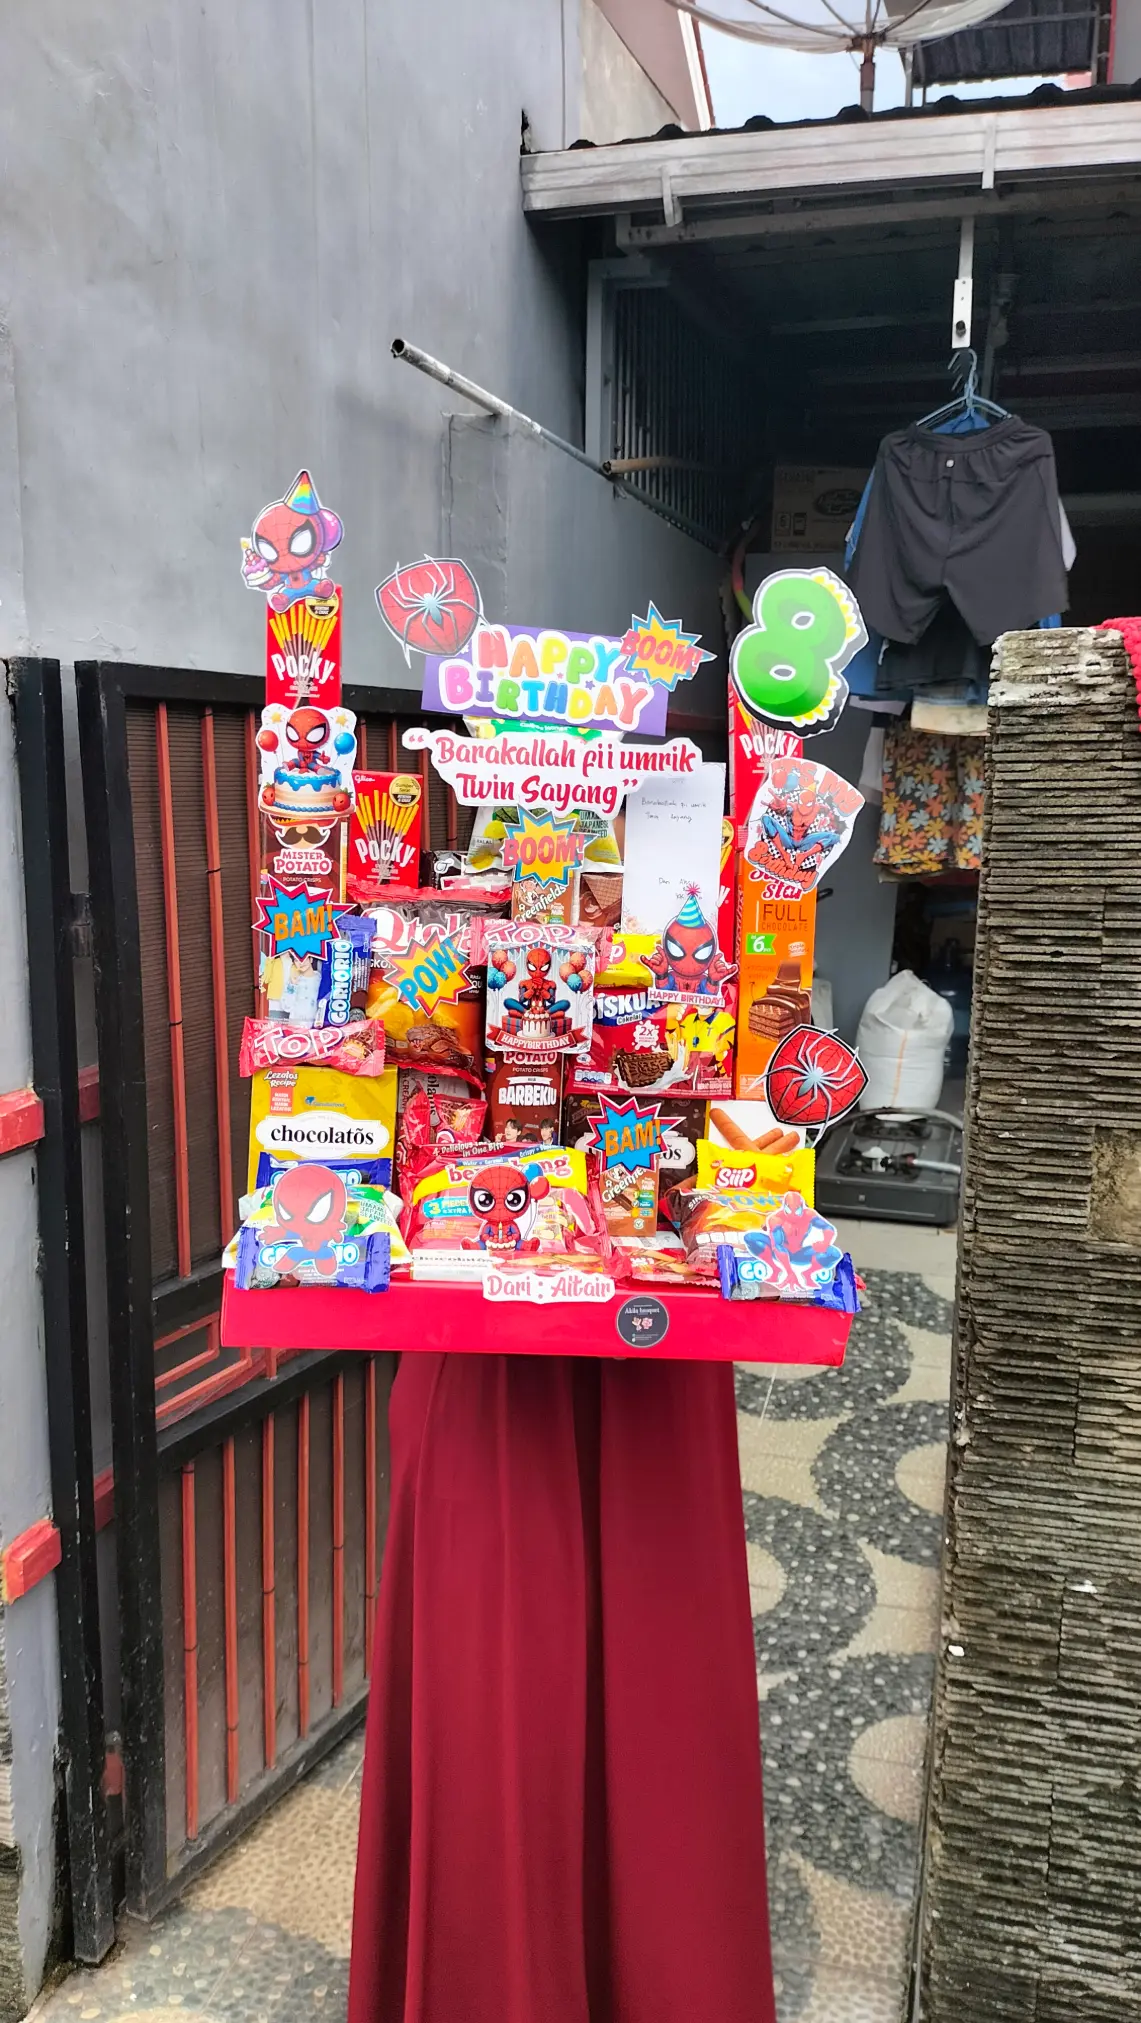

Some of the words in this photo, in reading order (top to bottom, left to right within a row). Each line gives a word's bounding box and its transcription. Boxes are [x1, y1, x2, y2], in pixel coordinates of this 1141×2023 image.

[477, 630, 620, 684] HAPPY
[620, 629, 703, 674] BOOM!
[736, 577, 848, 722] 8
[445, 664, 649, 725] BIRTHDAY
[620, 745, 697, 773] umrik
[456, 772, 515, 801] Twin
[282, 851, 323, 860] MISTER
[503, 834, 586, 867] BOOM!
[275, 859, 331, 873] POTATO
[273, 904, 334, 941] BAM!
[763, 903, 807, 922] FULL
[484, 923, 576, 945] TOP
[753, 935, 765, 953] 6
[328, 939, 353, 1026] GORIORIO
[398, 937, 466, 1010] POW!
[649, 989, 680, 1001] HAPPY
[681, 992, 724, 1006] BIRTHDAY!
[617, 1012, 642, 1025] Cokelat
[639, 1026, 654, 1036] 2x
[254, 1027, 345, 1064] TOP
[504, 1051, 557, 1064] POTATO
[263, 1070, 299, 1081] Lezatos
[269, 1079, 297, 1088] Recipe
[498, 1085, 558, 1107] BARBEKIU
[605, 1119, 662, 1157] BAM!
[428, 1201, 441, 1215] 3
[486, 1275, 531, 1297] Dari
